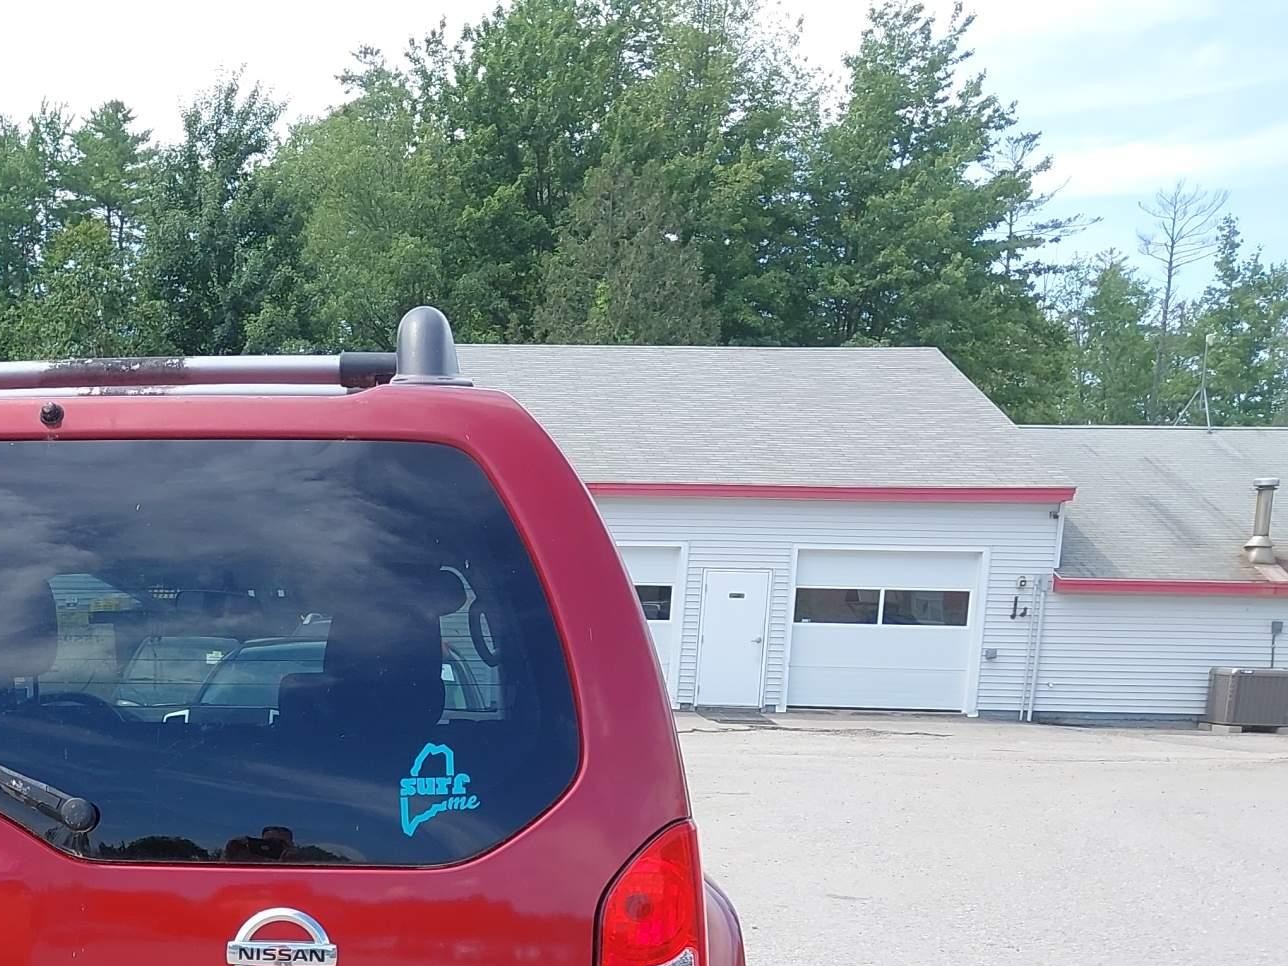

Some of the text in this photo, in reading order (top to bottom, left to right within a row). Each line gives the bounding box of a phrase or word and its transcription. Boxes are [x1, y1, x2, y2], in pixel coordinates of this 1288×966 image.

[400, 773, 470, 796] surf
[447, 795, 480, 810] me
[238, 947, 325, 963] NISSAN
